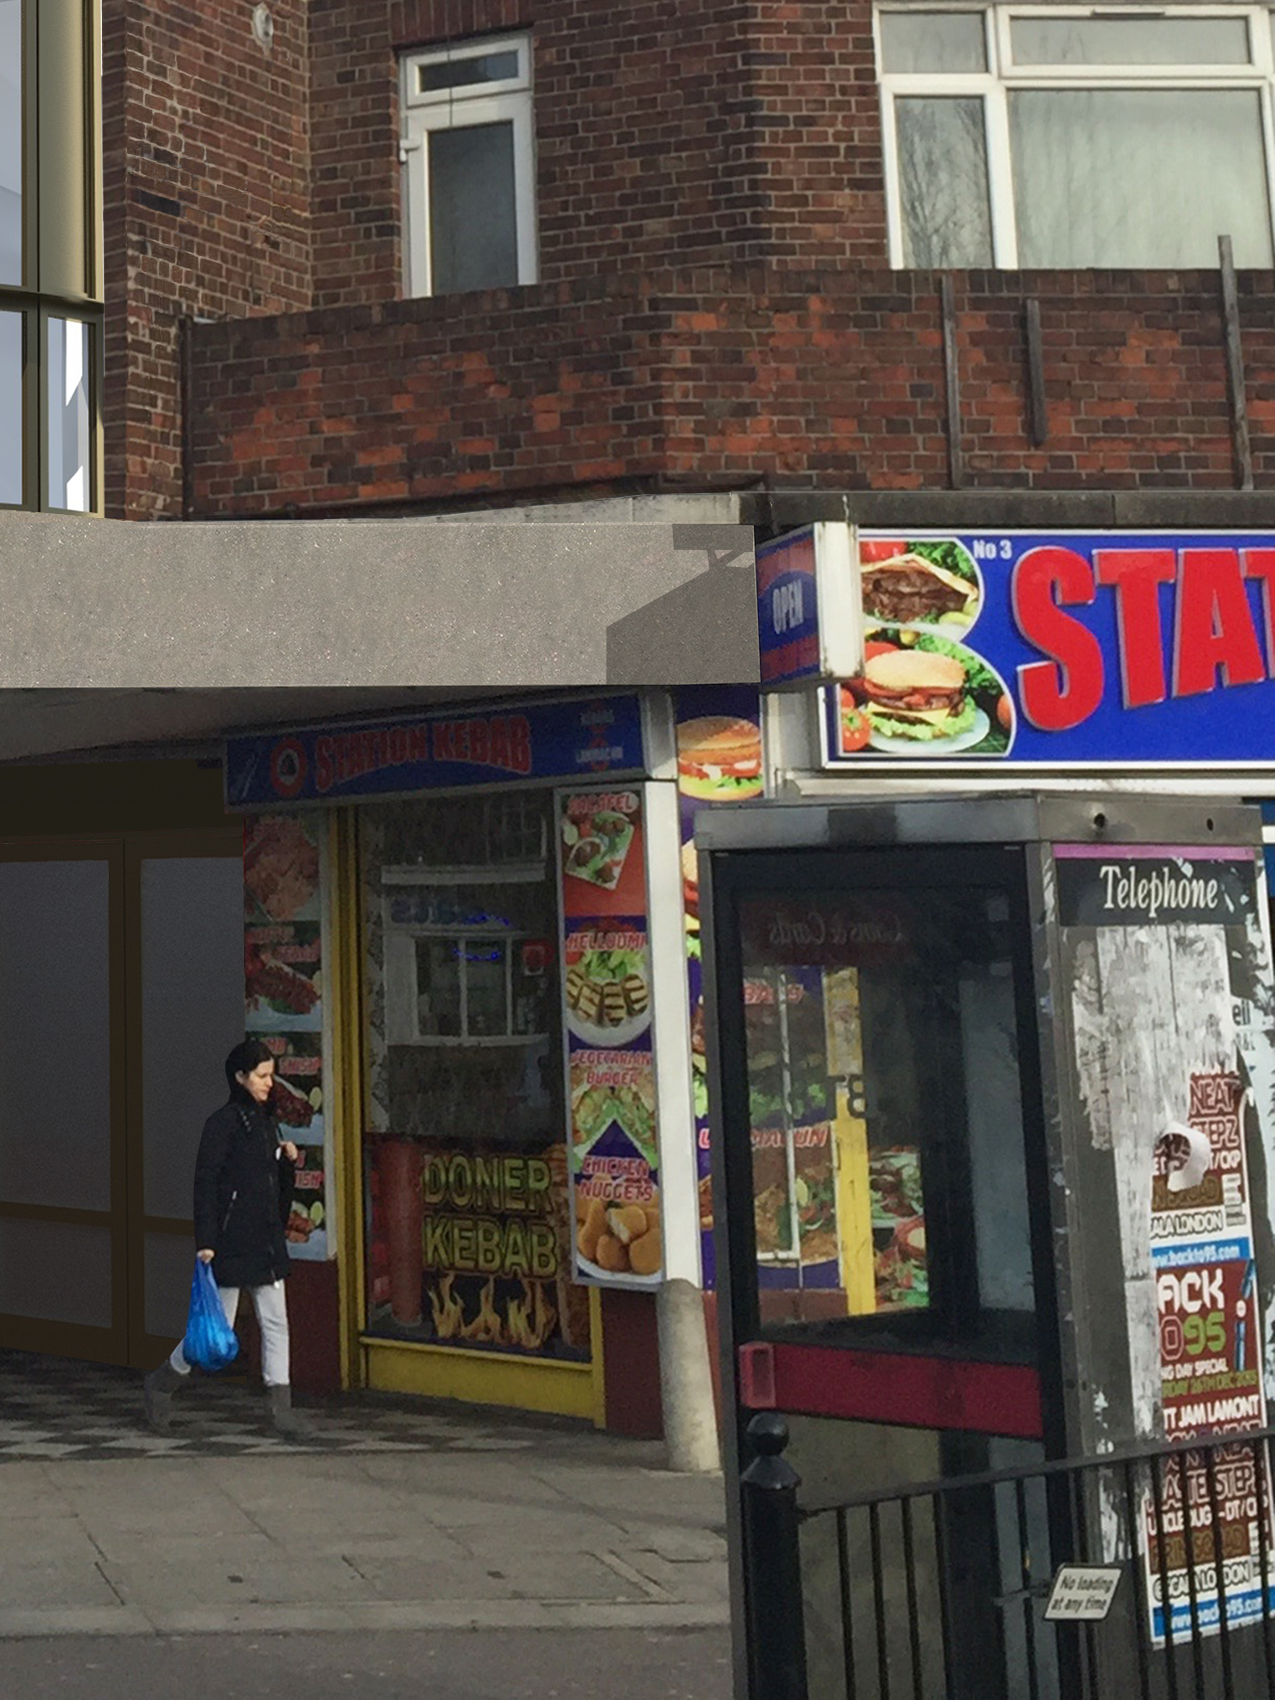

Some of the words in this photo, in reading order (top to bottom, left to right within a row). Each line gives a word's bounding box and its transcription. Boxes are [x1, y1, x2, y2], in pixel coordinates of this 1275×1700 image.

[973, 539, 997, 559] No
[1000, 539, 1012, 559] 3
[772, 578, 804, 635] OPEN
[315, 724, 427, 792] STATION
[433, 715, 533, 775] KEBAB
[1099, 864, 1219, 918] Telephone
[586, 1070, 639, 1085] BURGER
[1190, 1076, 1242, 1115] NEAT
[423, 1154, 554, 1212] DONER
[581, 1157, 651, 1177] CHICKEN
[580, 1178, 654, 1201] NUGGETS
[1174, 1209, 1224, 1236] LONDON
[422, 1215, 558, 1278] KEBAB
[1157, 1268, 1225, 1314] ACK
[1163, 1406, 1177, 1429] TT
[1178, 1402, 1206, 1428] JAM
[1206, 1394, 1260, 1424] LAMONT
[1060, 1575, 1076, 1591] No
[1076, 1575, 1115, 1593] loading
[1197, 1559, 1250, 1593] LODON
[1051, 1597, 1065, 1610] at
[1065, 1598, 1085, 1613] any
